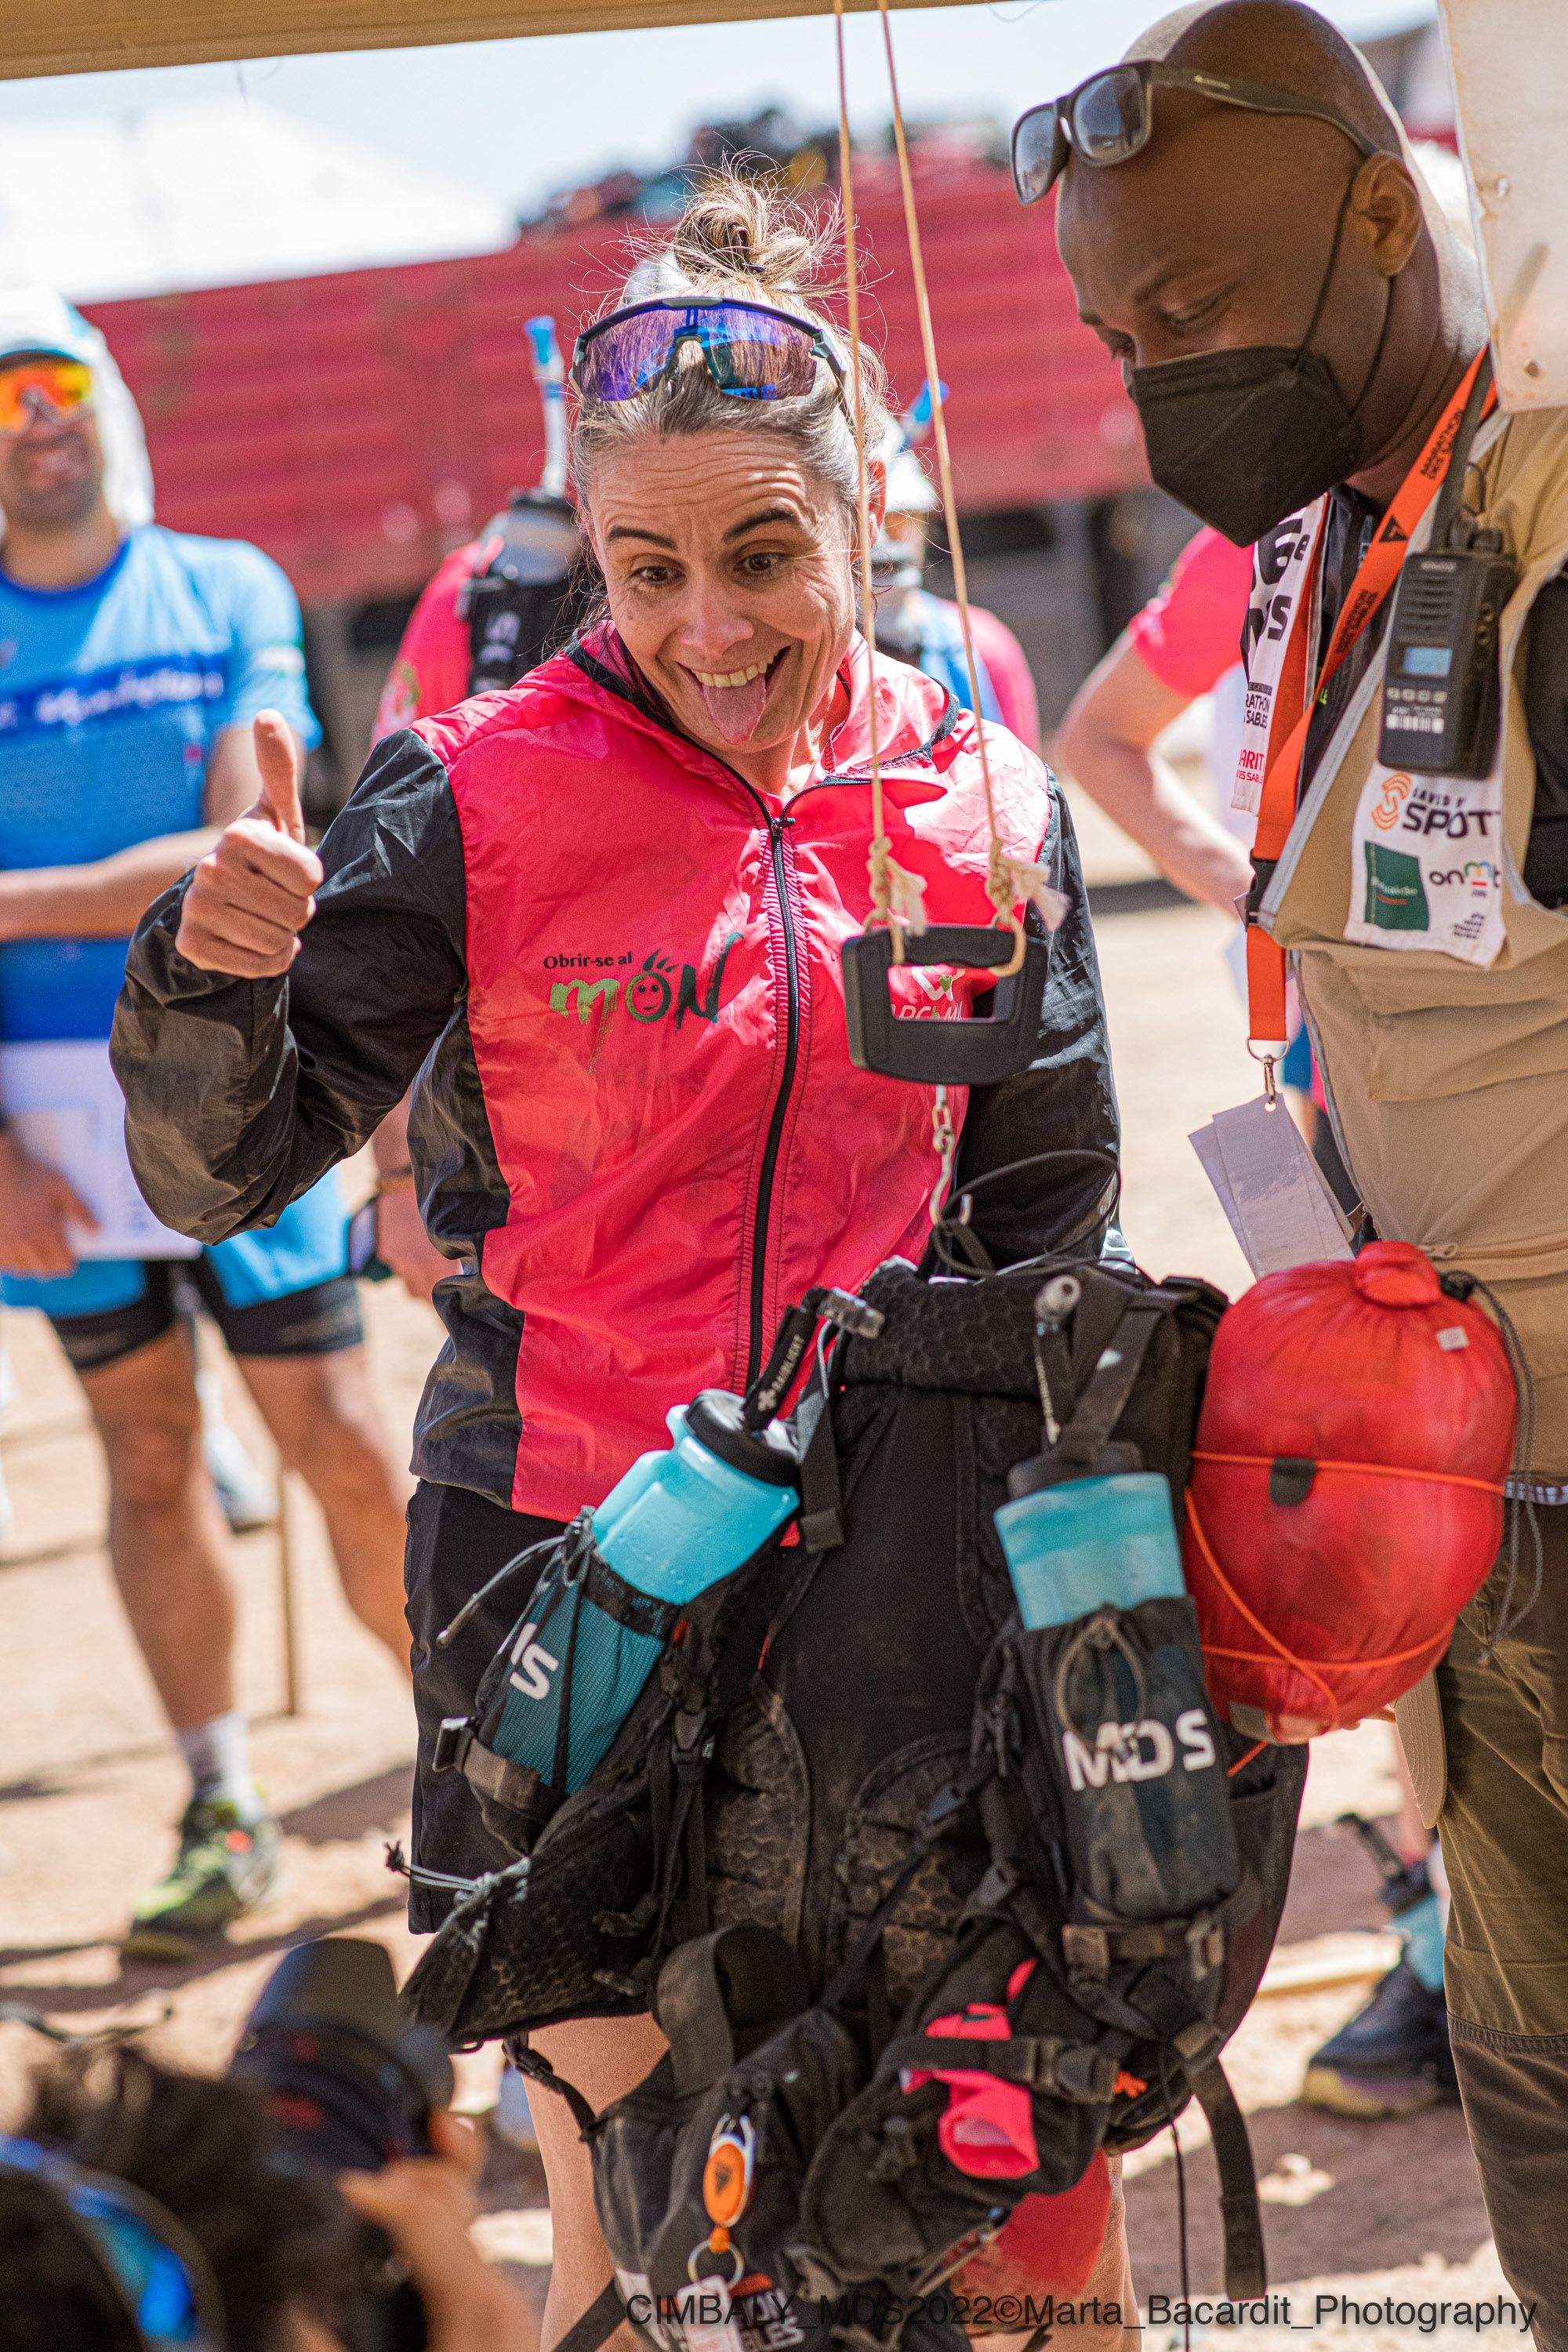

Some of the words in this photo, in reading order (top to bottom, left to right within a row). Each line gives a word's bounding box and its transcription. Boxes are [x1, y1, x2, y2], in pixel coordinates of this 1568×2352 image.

[1402, 803, 1493, 839] SPOT
[543, 953, 614, 970] Obrir-se
[619, 952, 632, 965] al
[1062, 1708, 1216, 1791] MDS
